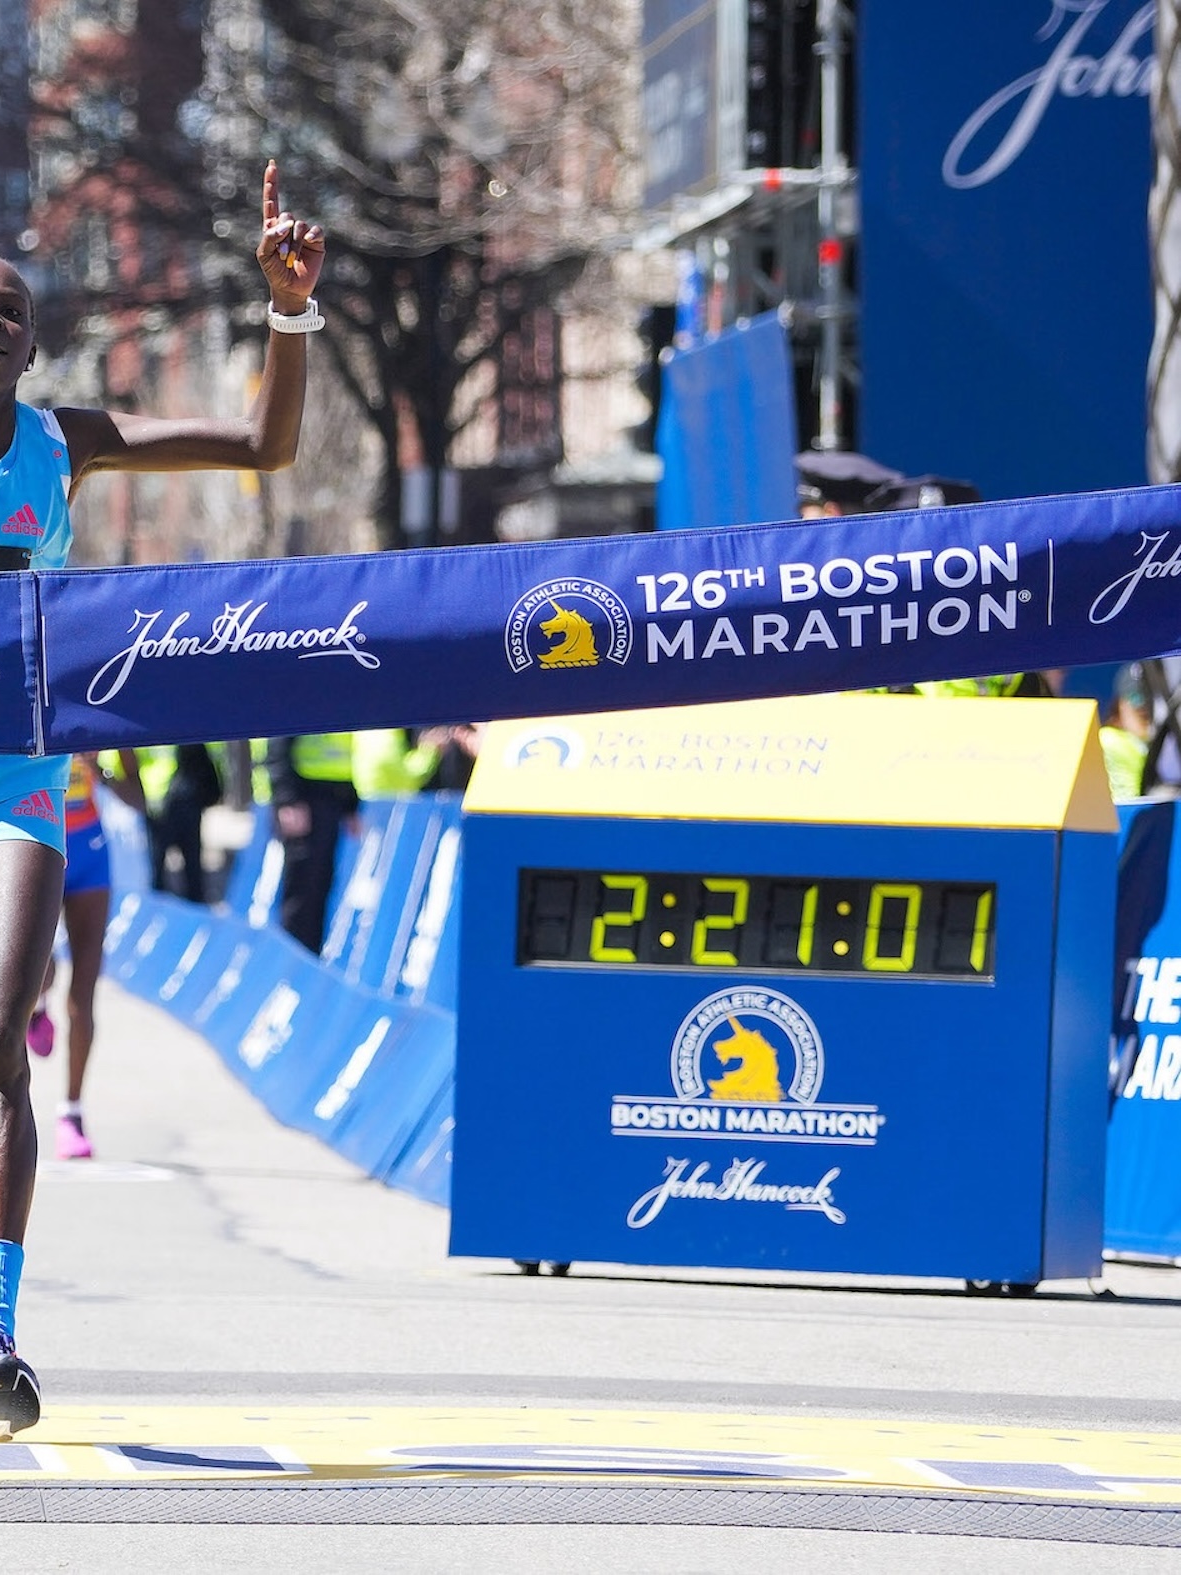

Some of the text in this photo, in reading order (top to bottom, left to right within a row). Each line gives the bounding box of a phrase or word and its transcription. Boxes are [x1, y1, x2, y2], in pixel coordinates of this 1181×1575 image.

[1, 522, 45, 537] adidas
[636, 541, 1017, 613] 126TH BOSTON
[512, 581, 627, 666] BOSTON ATHLETIC ASSOCIATION
[11, 805, 61, 826] adidas
[589, 875, 993, 973] 2:21:01
[678, 993, 817, 1098] BOSTON ATHLETIC ASSOCIATION
[611, 1103, 720, 1130] BOSTON
